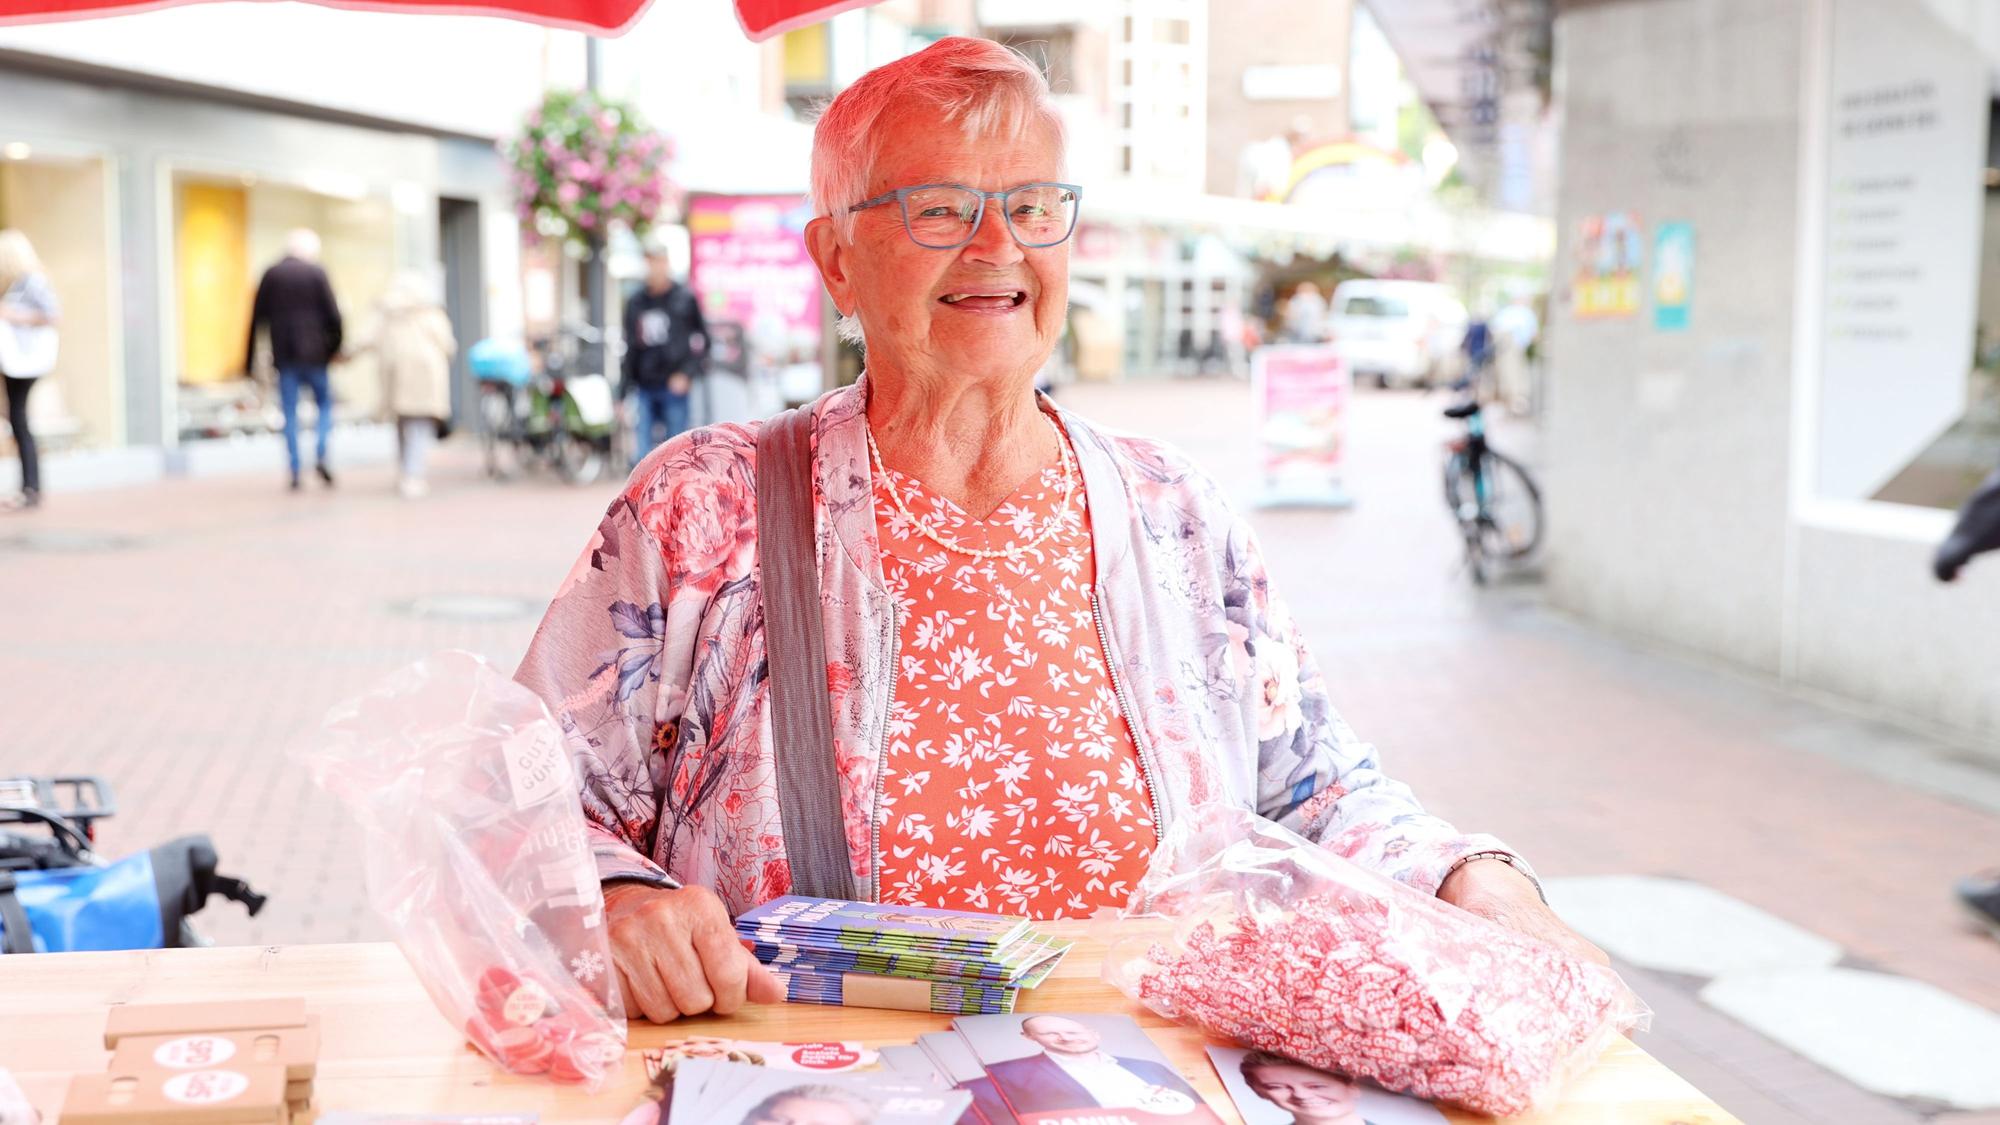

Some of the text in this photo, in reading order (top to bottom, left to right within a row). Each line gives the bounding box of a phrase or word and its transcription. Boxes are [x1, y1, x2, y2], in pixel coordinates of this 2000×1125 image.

[519, 736, 548, 770] GUT
[1221, 1018, 1241, 1033] SPD
[1256, 1034, 1277, 1045] SPD
[1290, 1035, 1311, 1047] SPD
